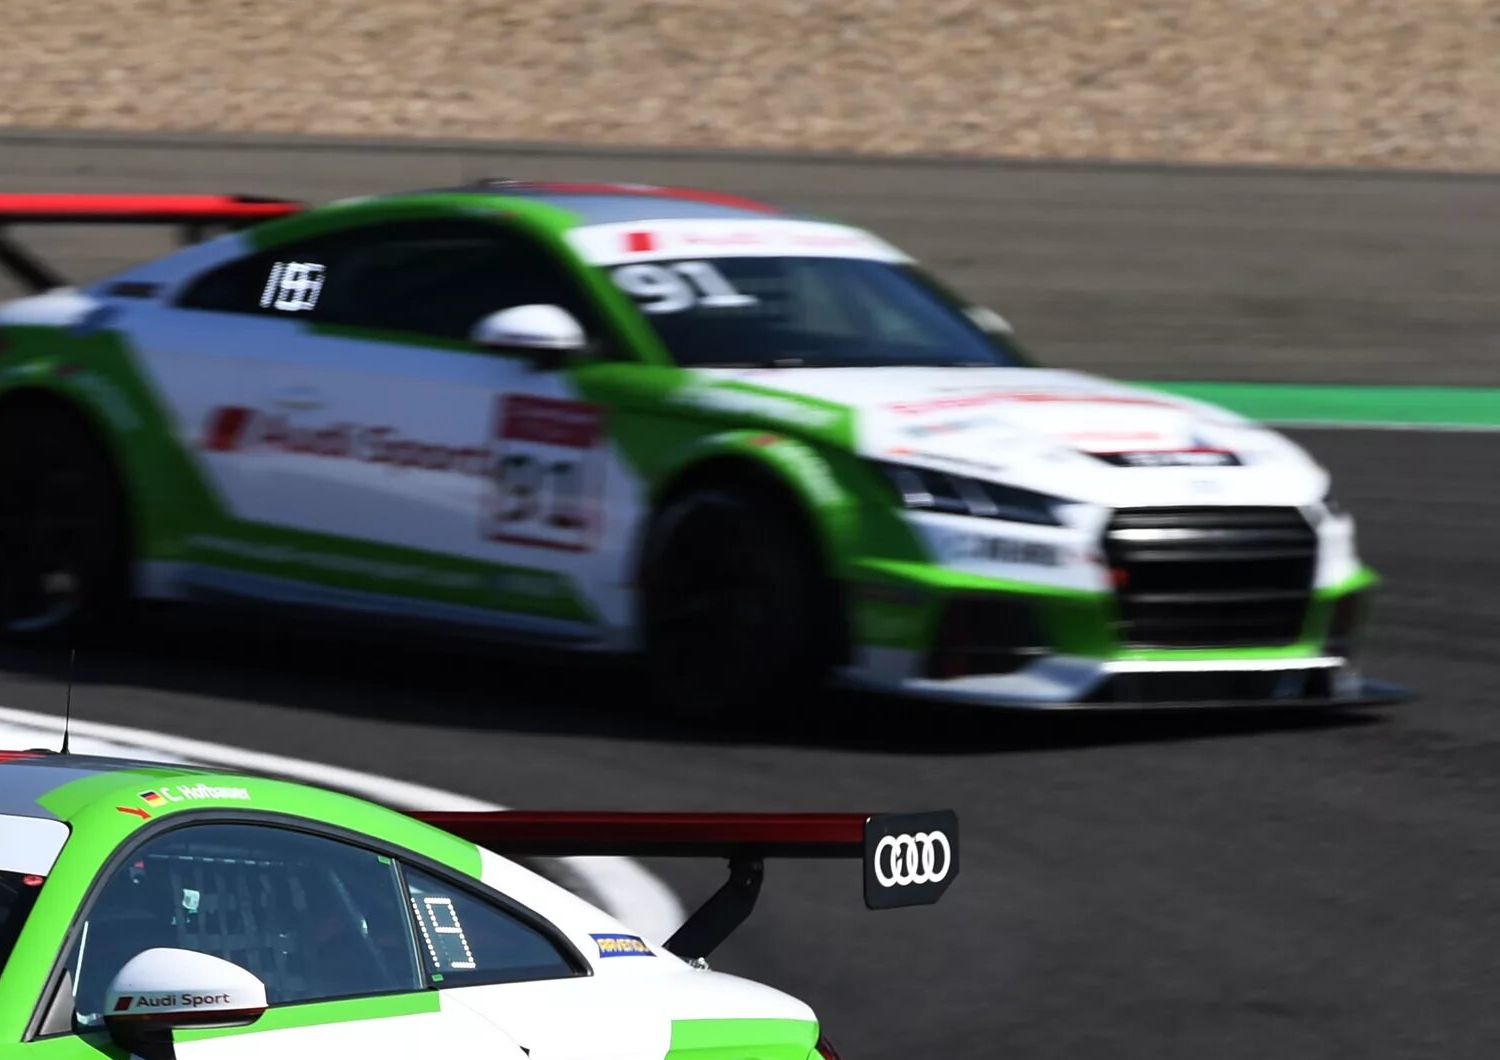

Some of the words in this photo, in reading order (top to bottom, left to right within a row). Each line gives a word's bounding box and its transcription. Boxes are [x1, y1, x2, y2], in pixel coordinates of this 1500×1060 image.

[610, 260, 758, 314] 91
[137, 994, 176, 1007] Audi
[181, 993, 230, 1008] Sport
